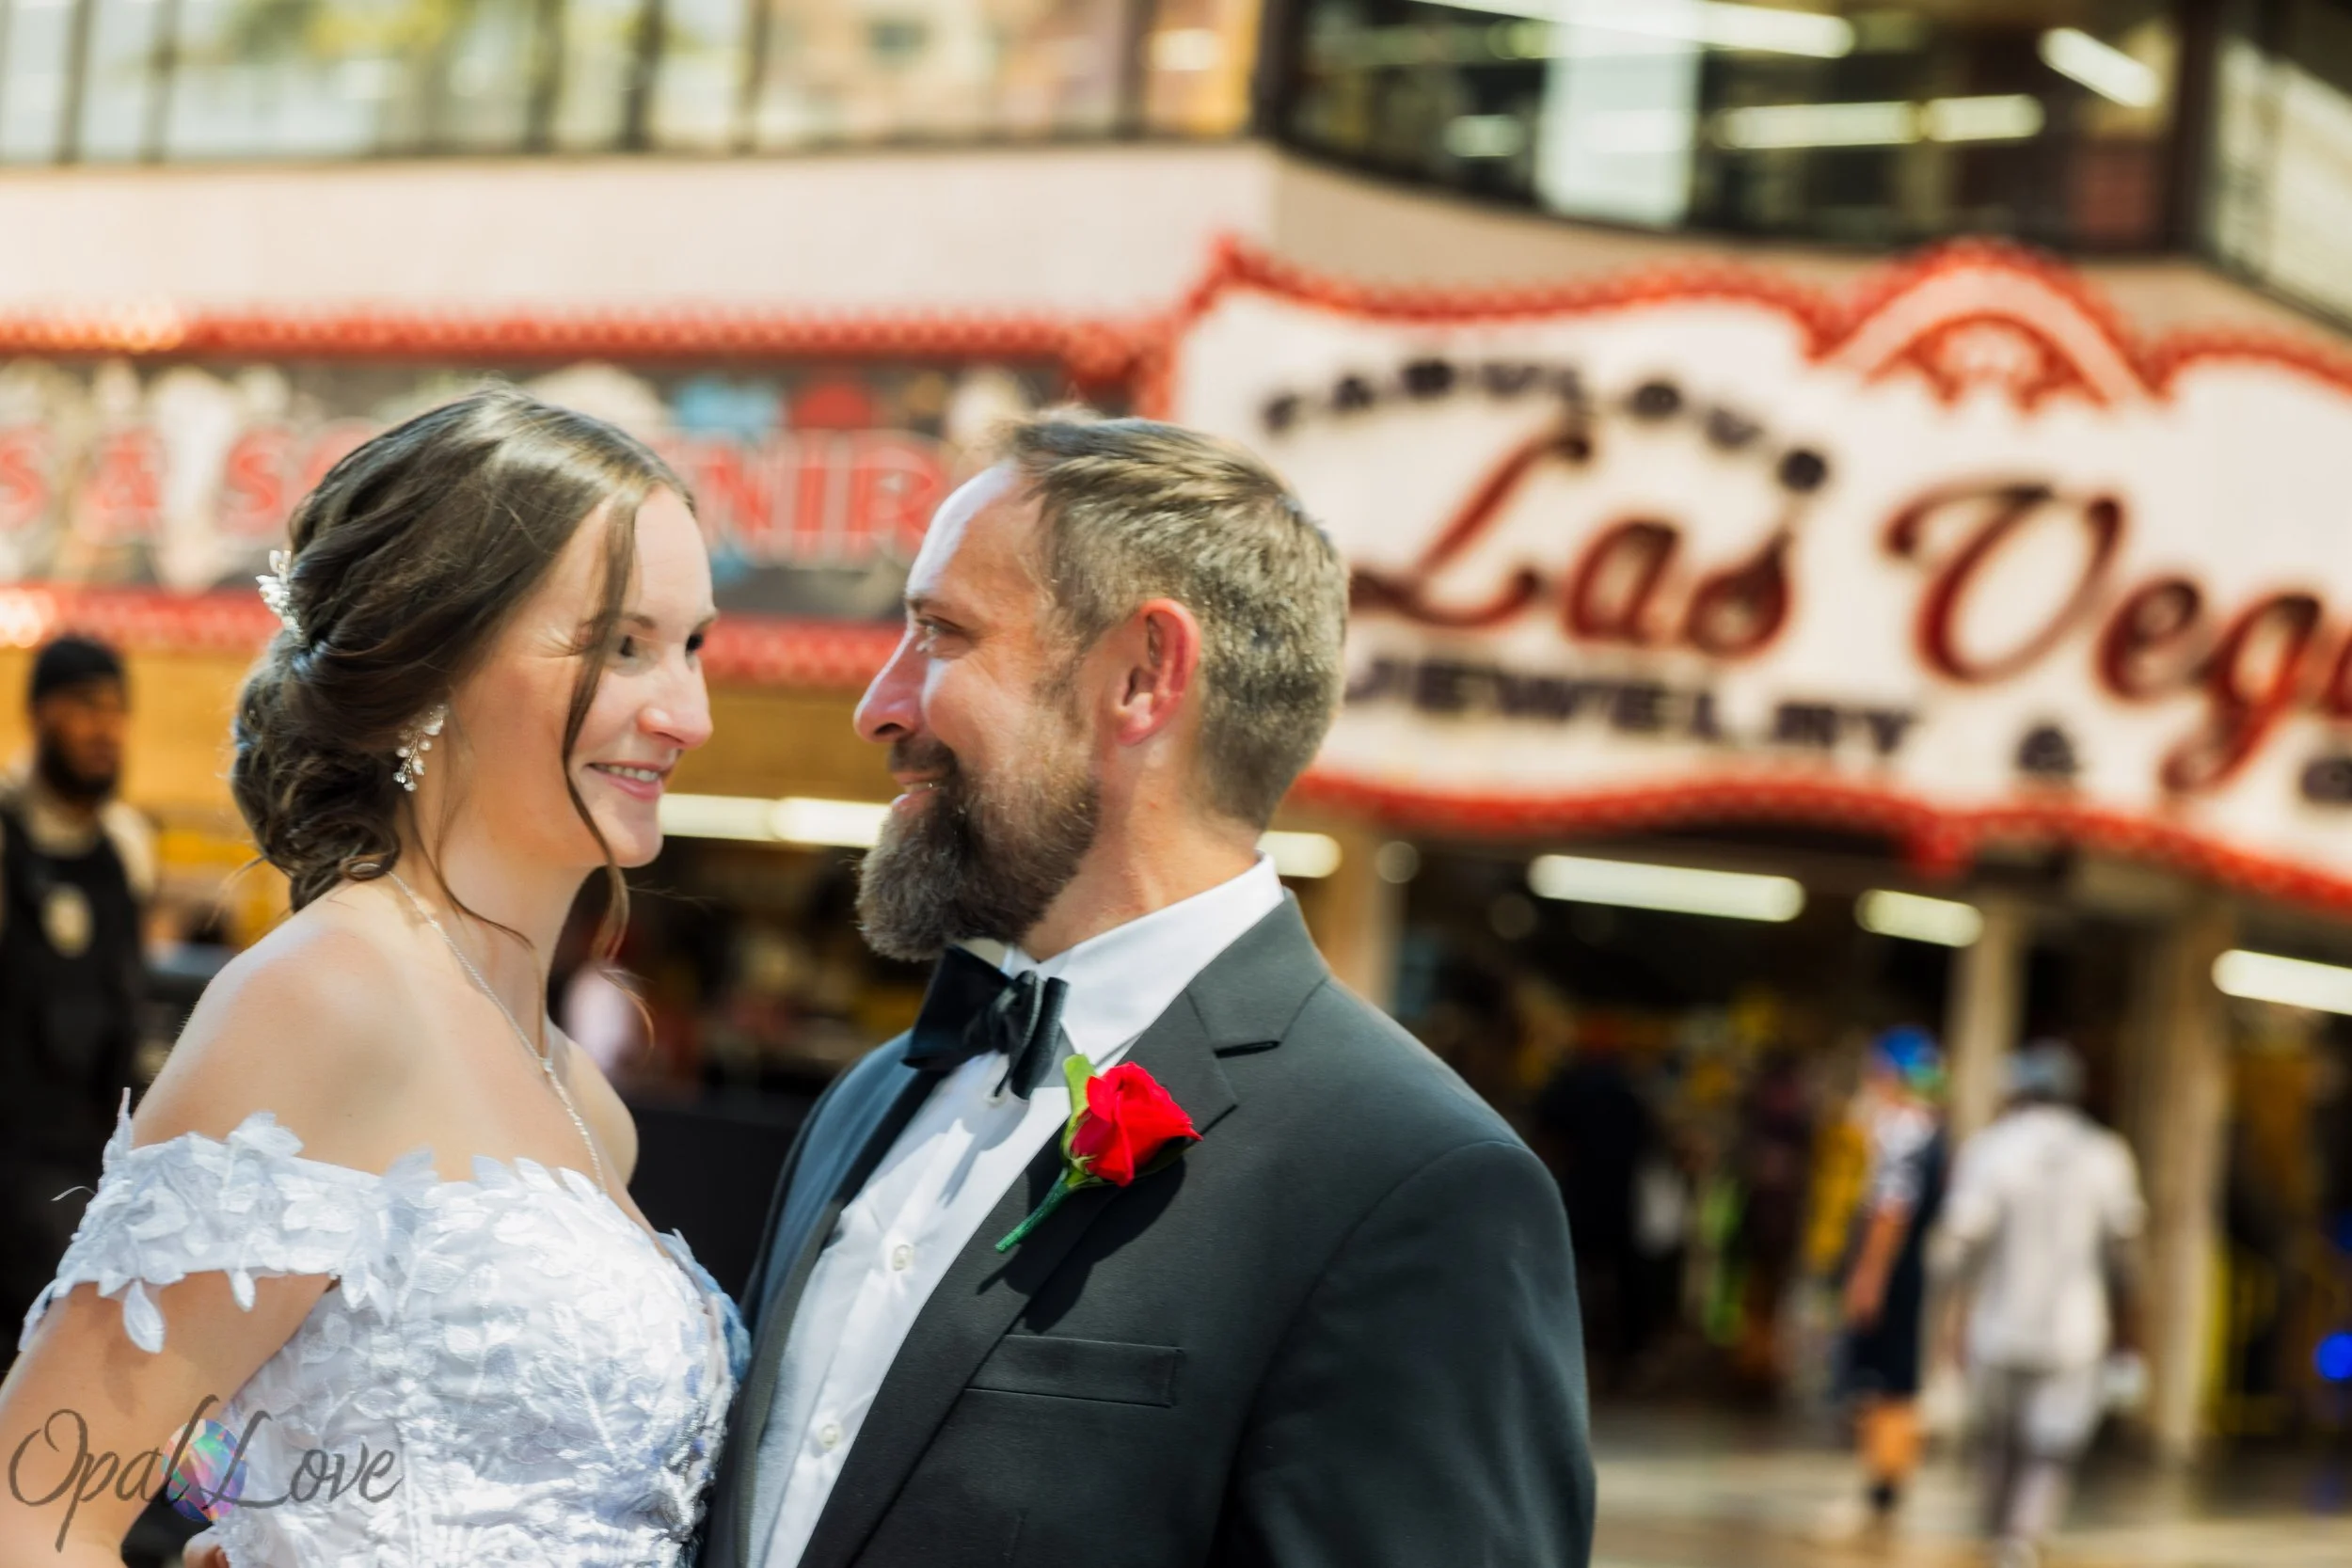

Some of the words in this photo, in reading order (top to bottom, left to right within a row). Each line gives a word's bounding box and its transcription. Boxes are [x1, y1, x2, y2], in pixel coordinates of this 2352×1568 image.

[1345, 653, 1914, 756] JEWELRY
[1347, 425, 1795, 660] Las
[1883, 480, 2352, 796] Veg
